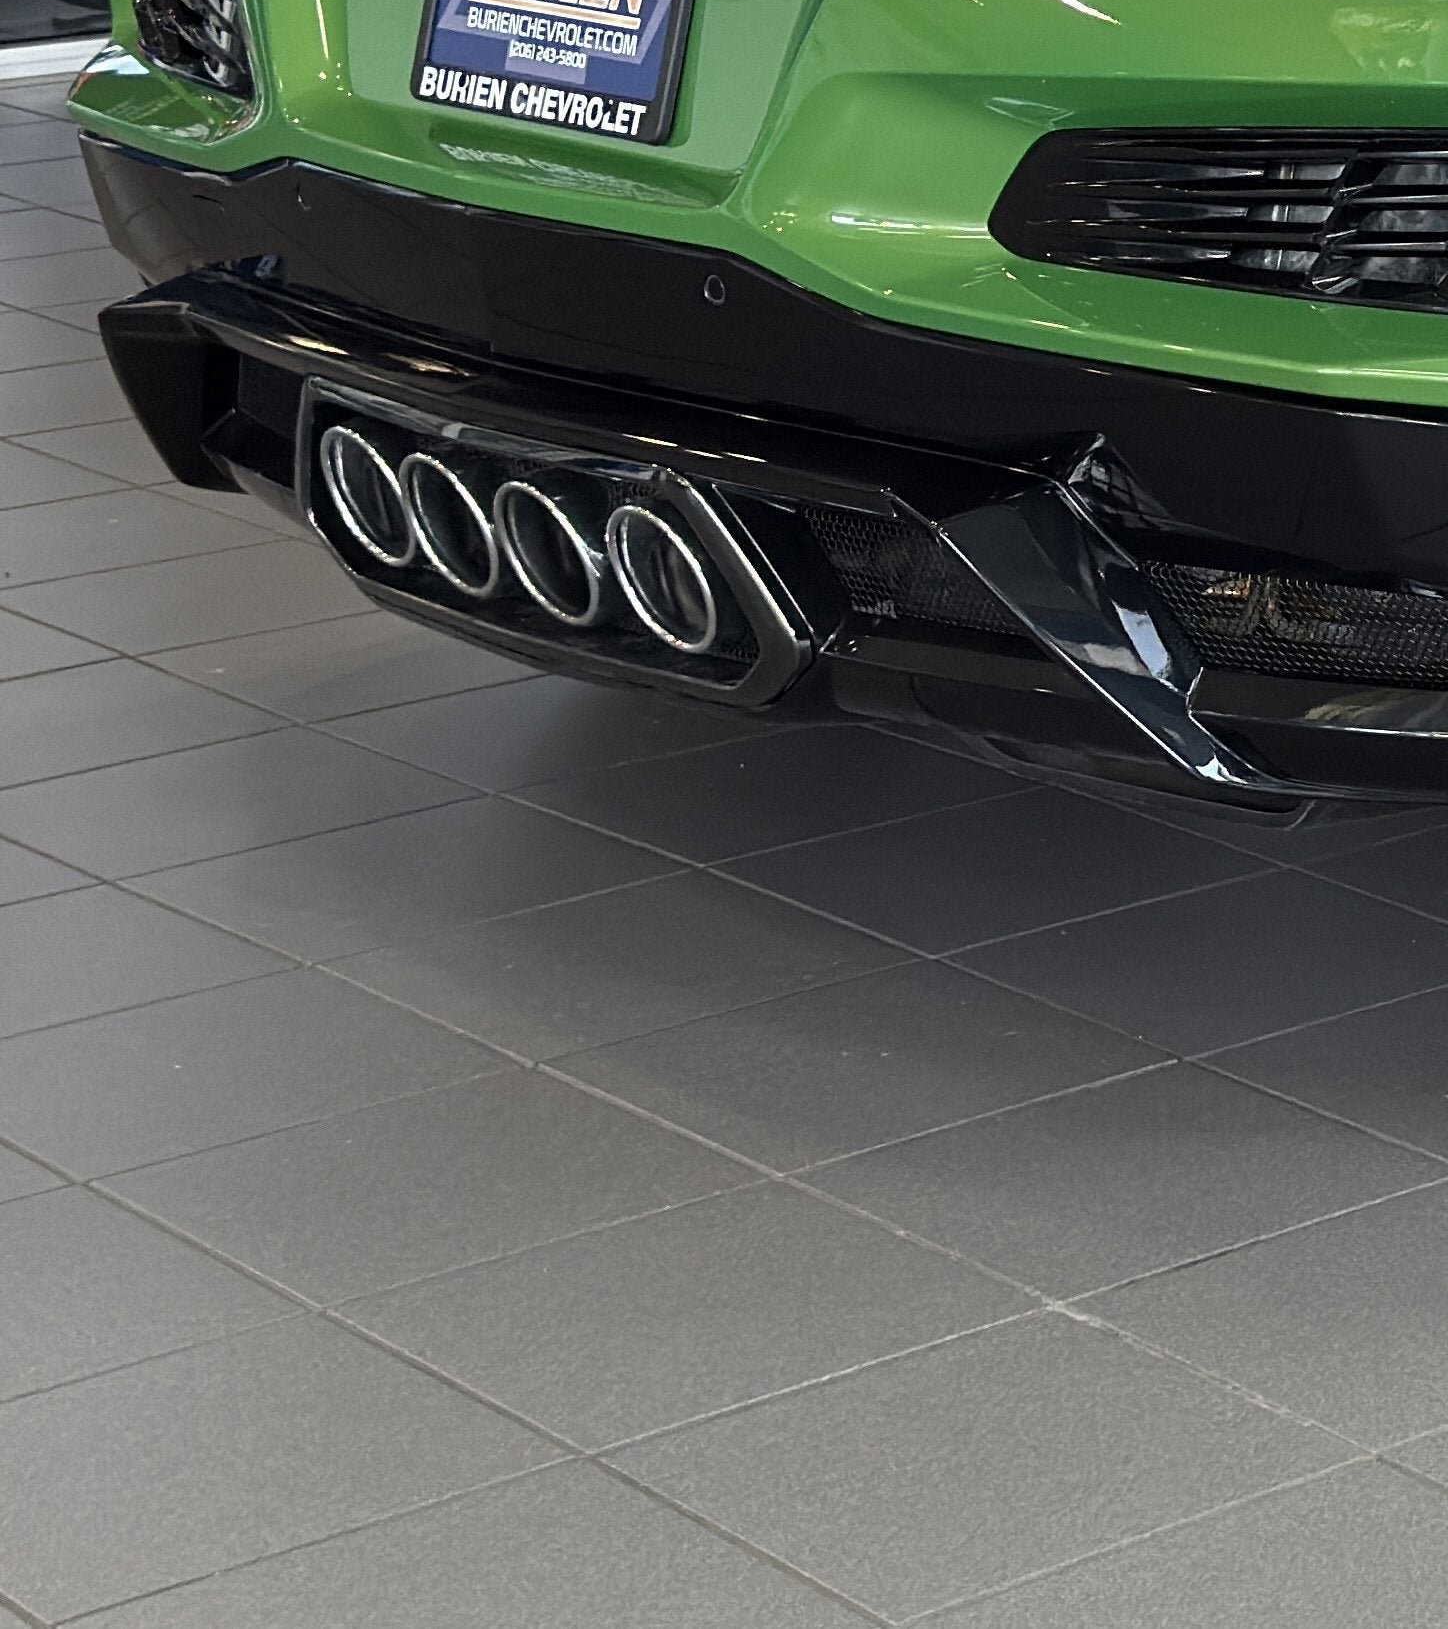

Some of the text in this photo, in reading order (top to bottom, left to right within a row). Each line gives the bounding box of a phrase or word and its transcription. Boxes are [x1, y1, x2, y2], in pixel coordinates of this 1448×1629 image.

[467, 7, 638, 57] BURIENCHEVROLET.COM
[509, 40, 586, 69] (206) 243-5800
[419, 65, 647, 136] BURIEN CHEVROLET
